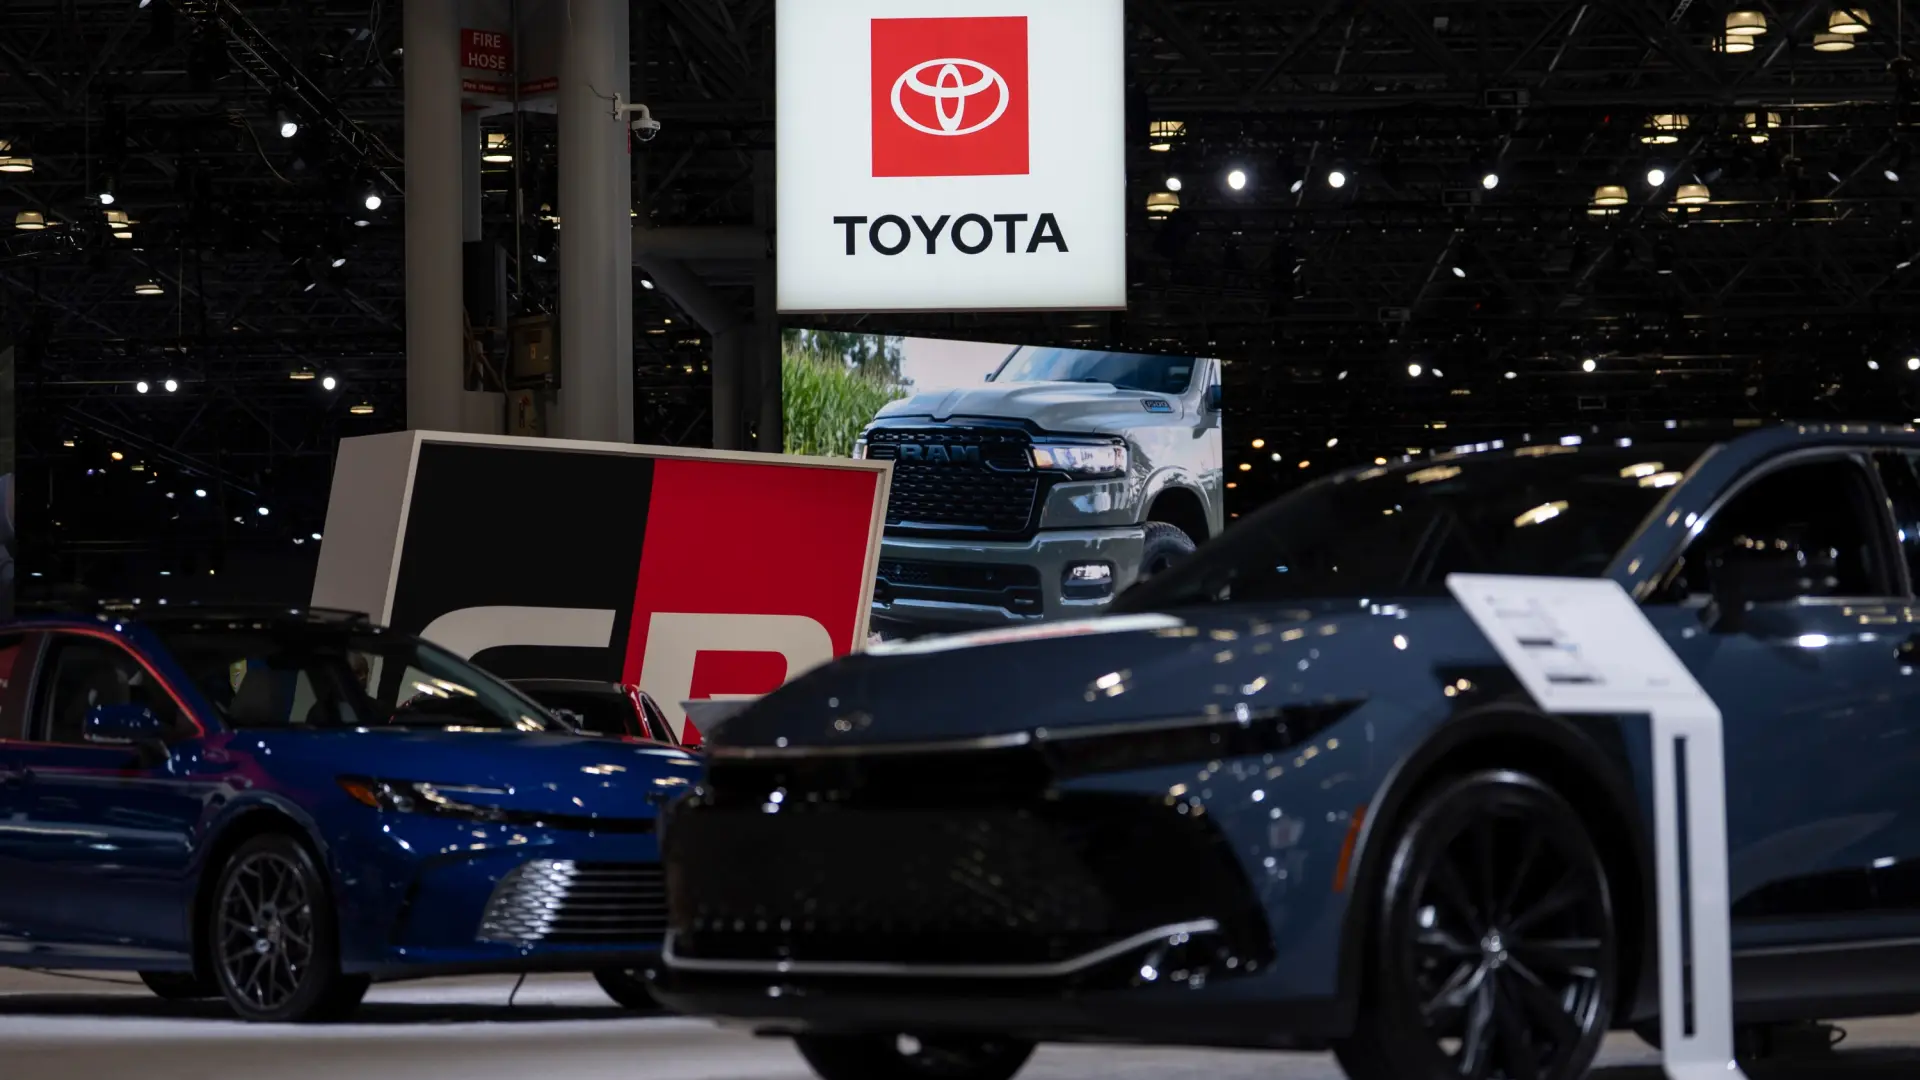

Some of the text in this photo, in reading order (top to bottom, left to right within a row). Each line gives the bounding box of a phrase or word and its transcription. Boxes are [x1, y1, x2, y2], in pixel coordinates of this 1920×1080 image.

[473, 32, 502, 48] FIRE
[468, 52, 506, 69] HOSE
[833, 213, 1069, 256] TOYOTA
[900, 443, 980, 462] RAM
